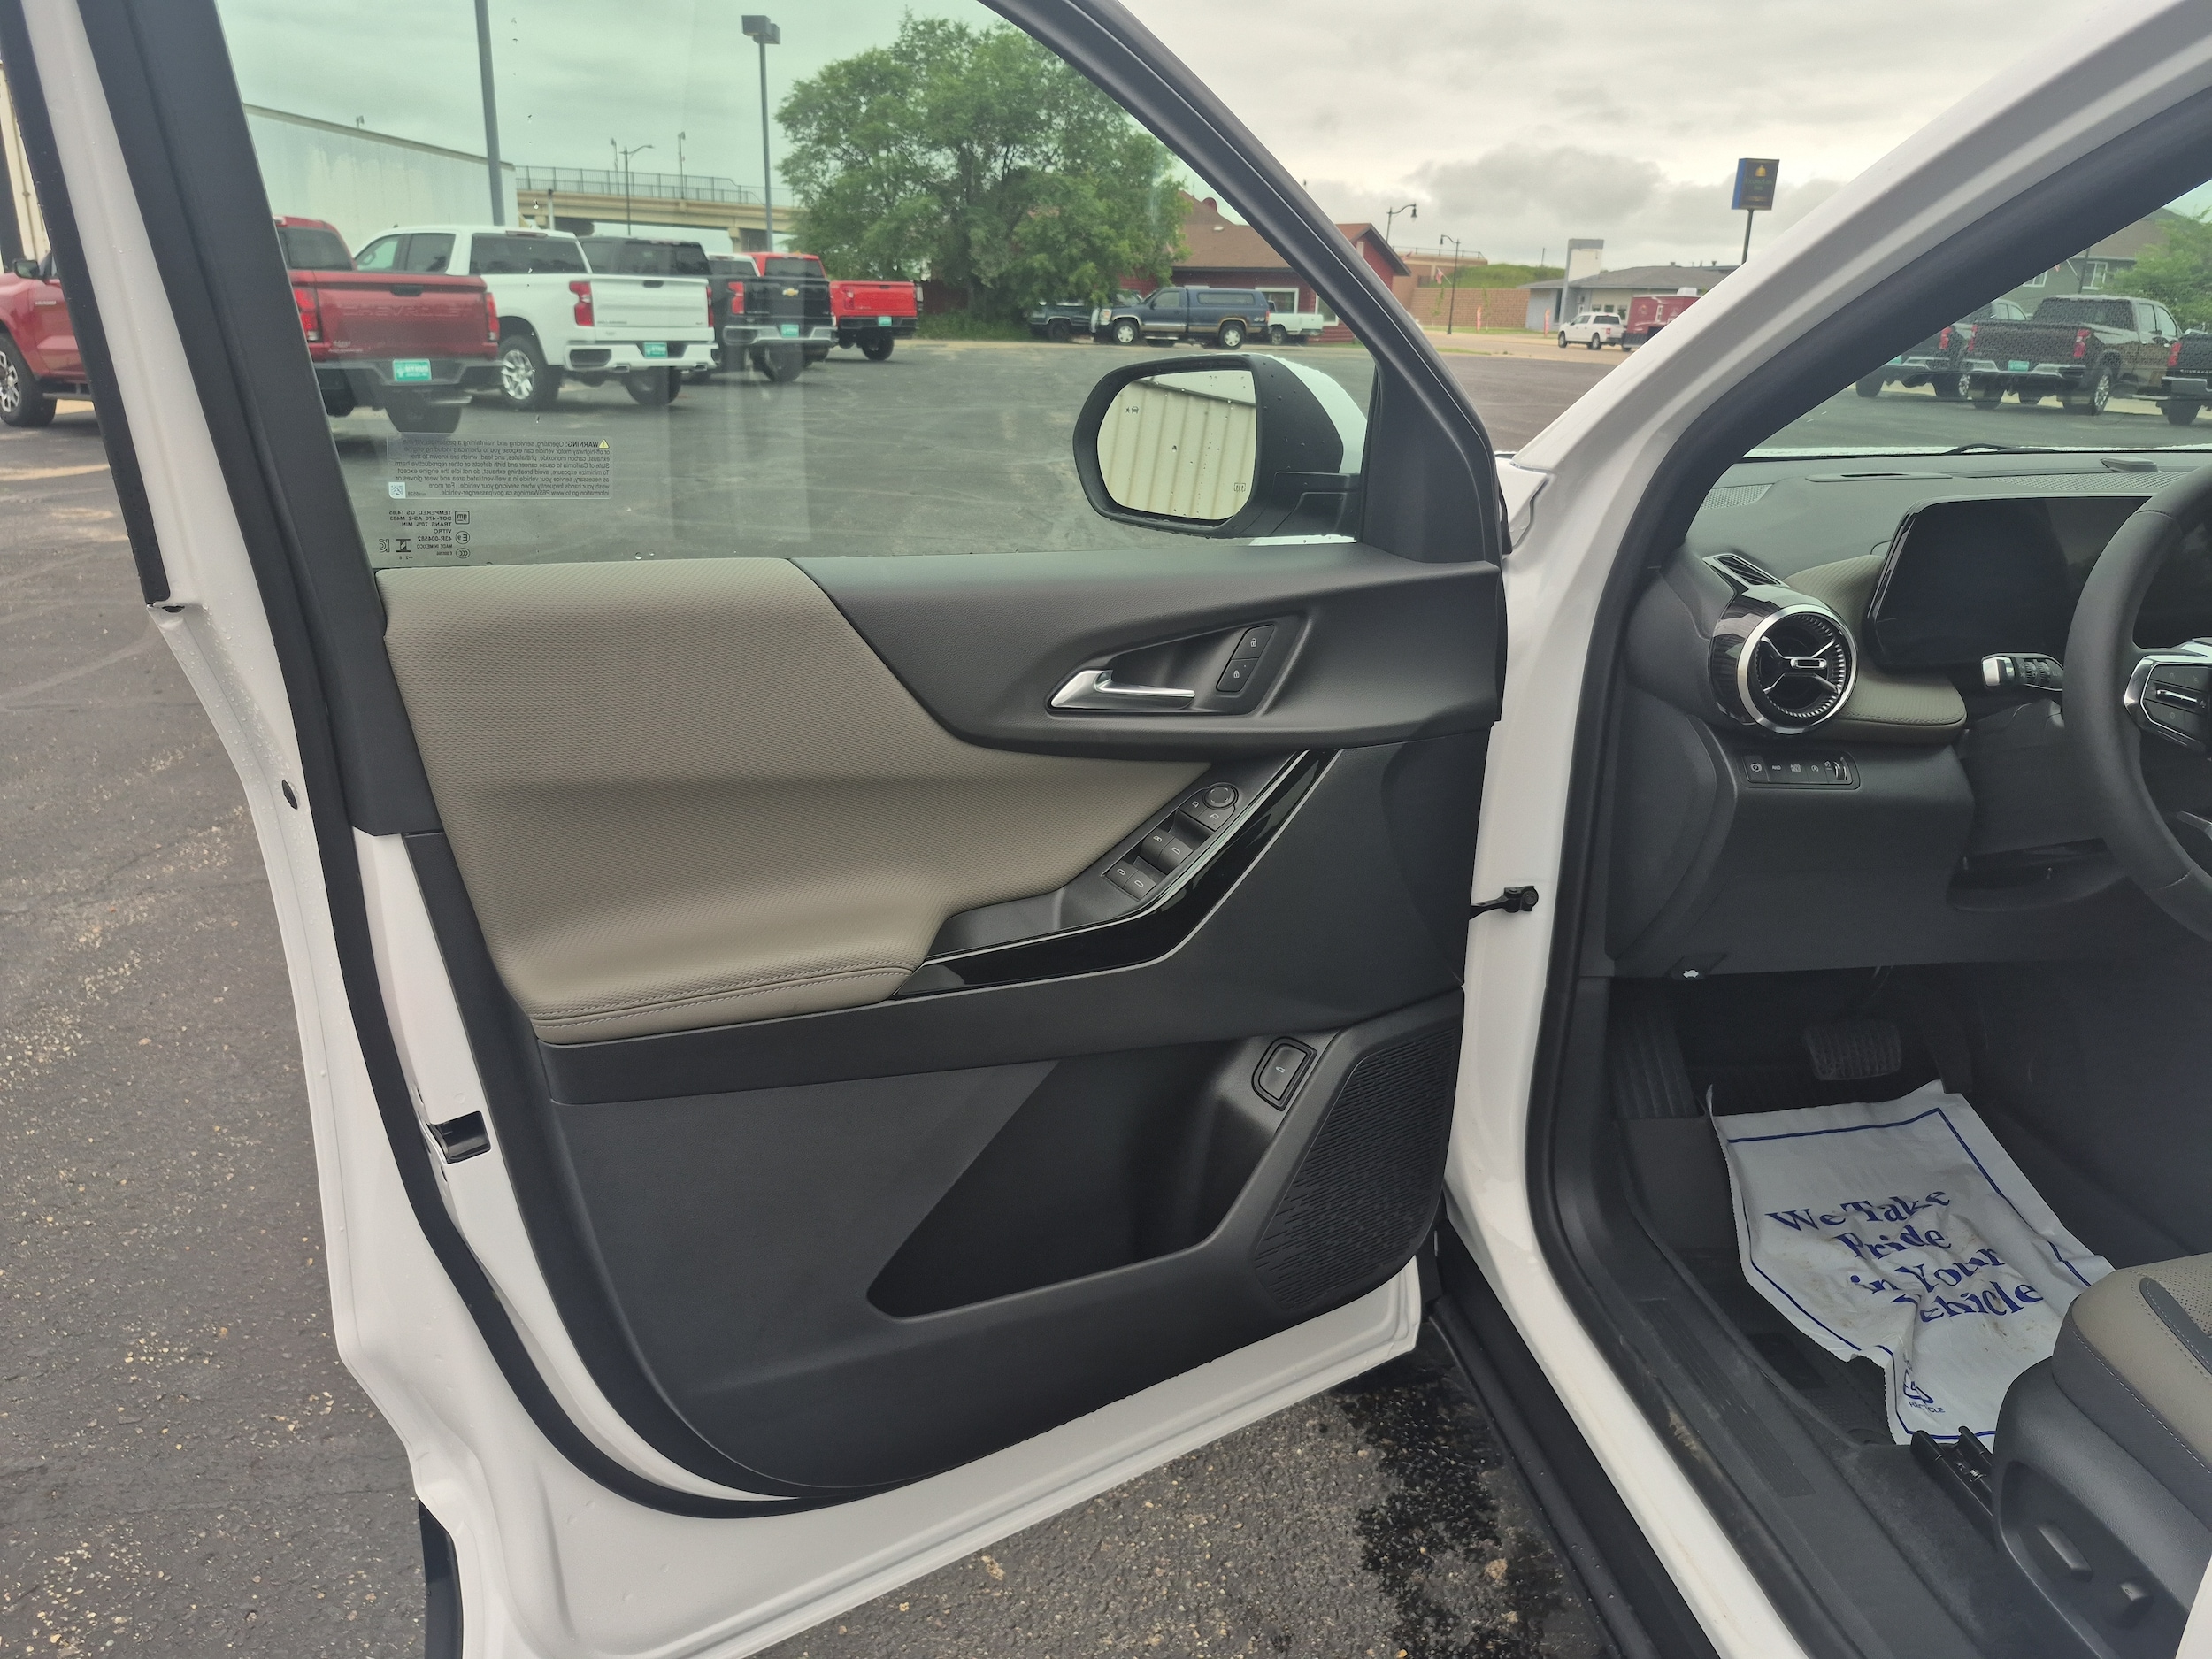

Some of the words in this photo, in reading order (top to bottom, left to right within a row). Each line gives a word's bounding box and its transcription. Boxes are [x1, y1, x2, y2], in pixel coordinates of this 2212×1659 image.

[1764, 1208, 1846, 1232] We
[1840, 1191, 1950, 1223] Take
[1832, 1224, 1952, 1261] Pride
[1849, 1274, 1903, 1294] in
[1893, 1248, 2006, 1294] Your
